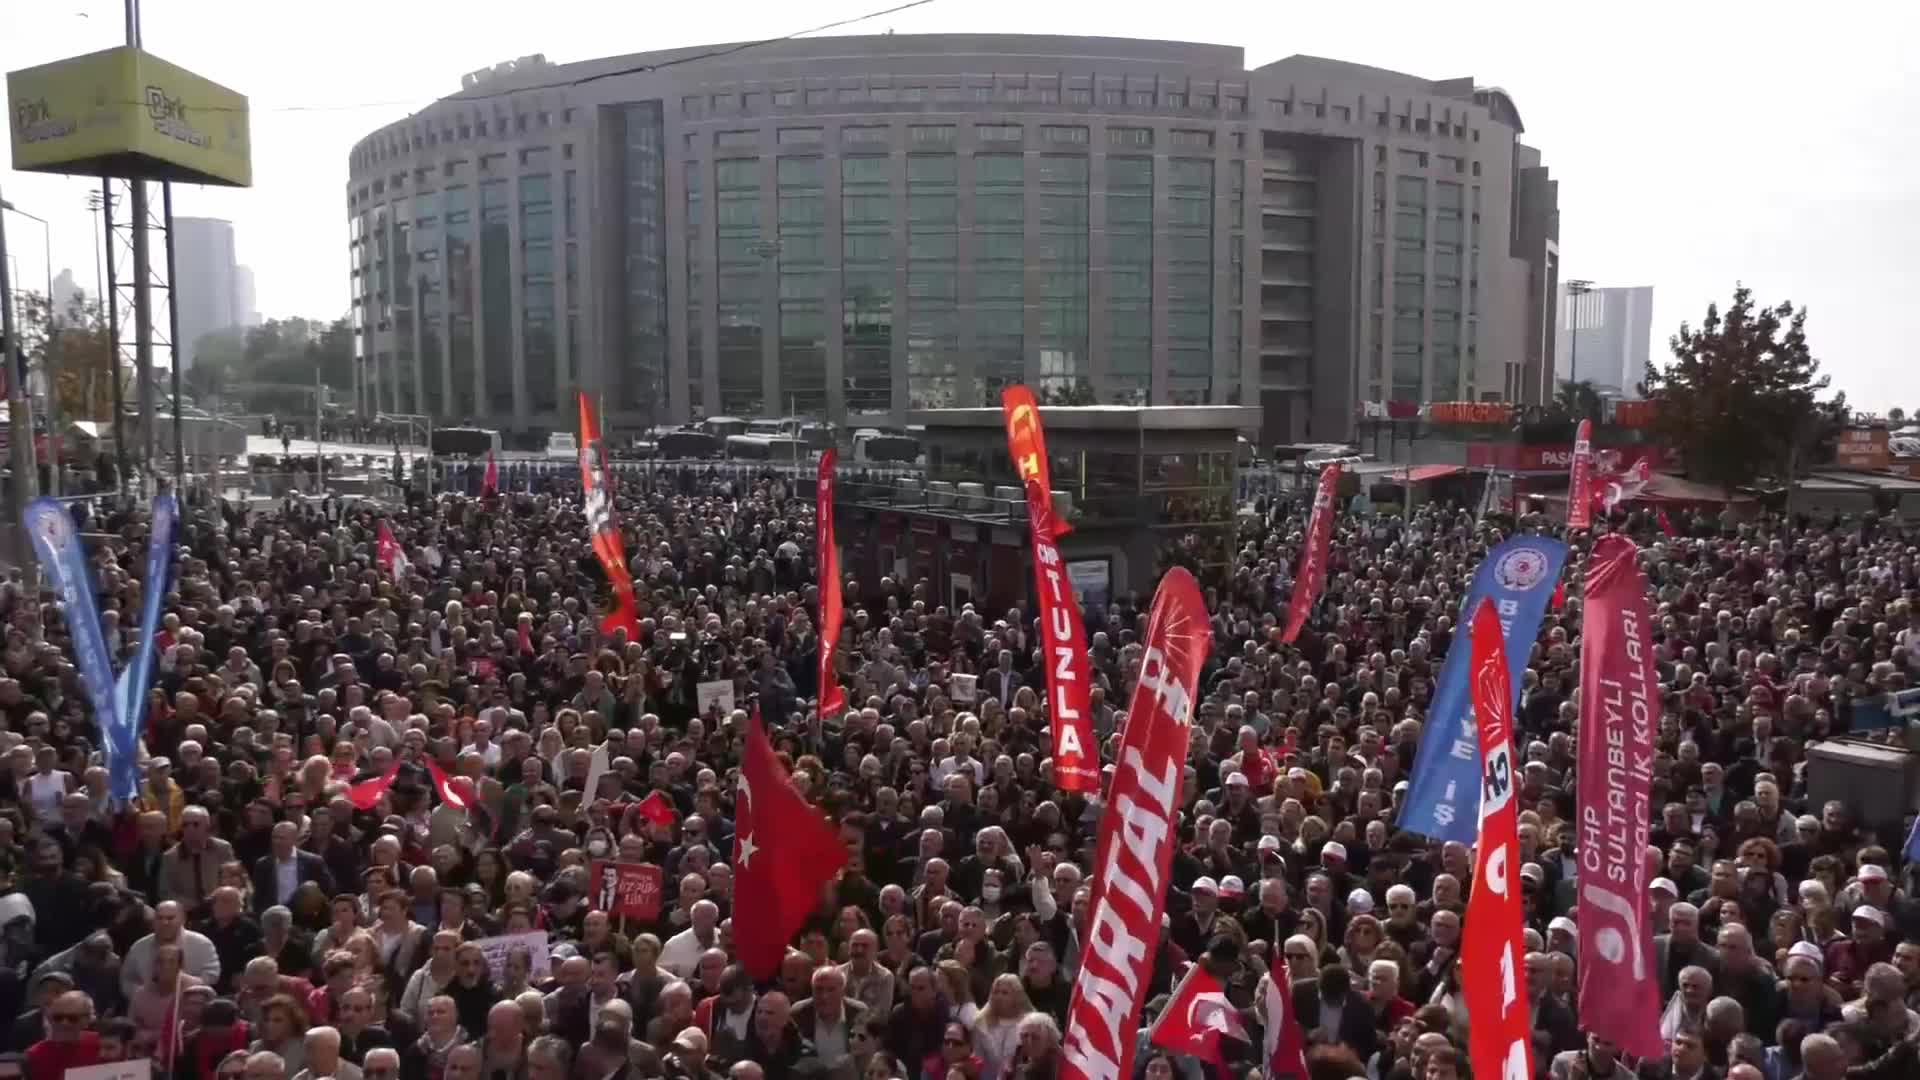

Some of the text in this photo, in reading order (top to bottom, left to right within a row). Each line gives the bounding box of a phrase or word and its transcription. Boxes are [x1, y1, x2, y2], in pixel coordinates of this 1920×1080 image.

[1047, 570, 1084, 757] TUZLA
[1621, 608, 1651, 746] KOLLARI
[1583, 806, 1602, 873] CHP
[1599, 678, 1627, 884] SULTANBEYLİ
